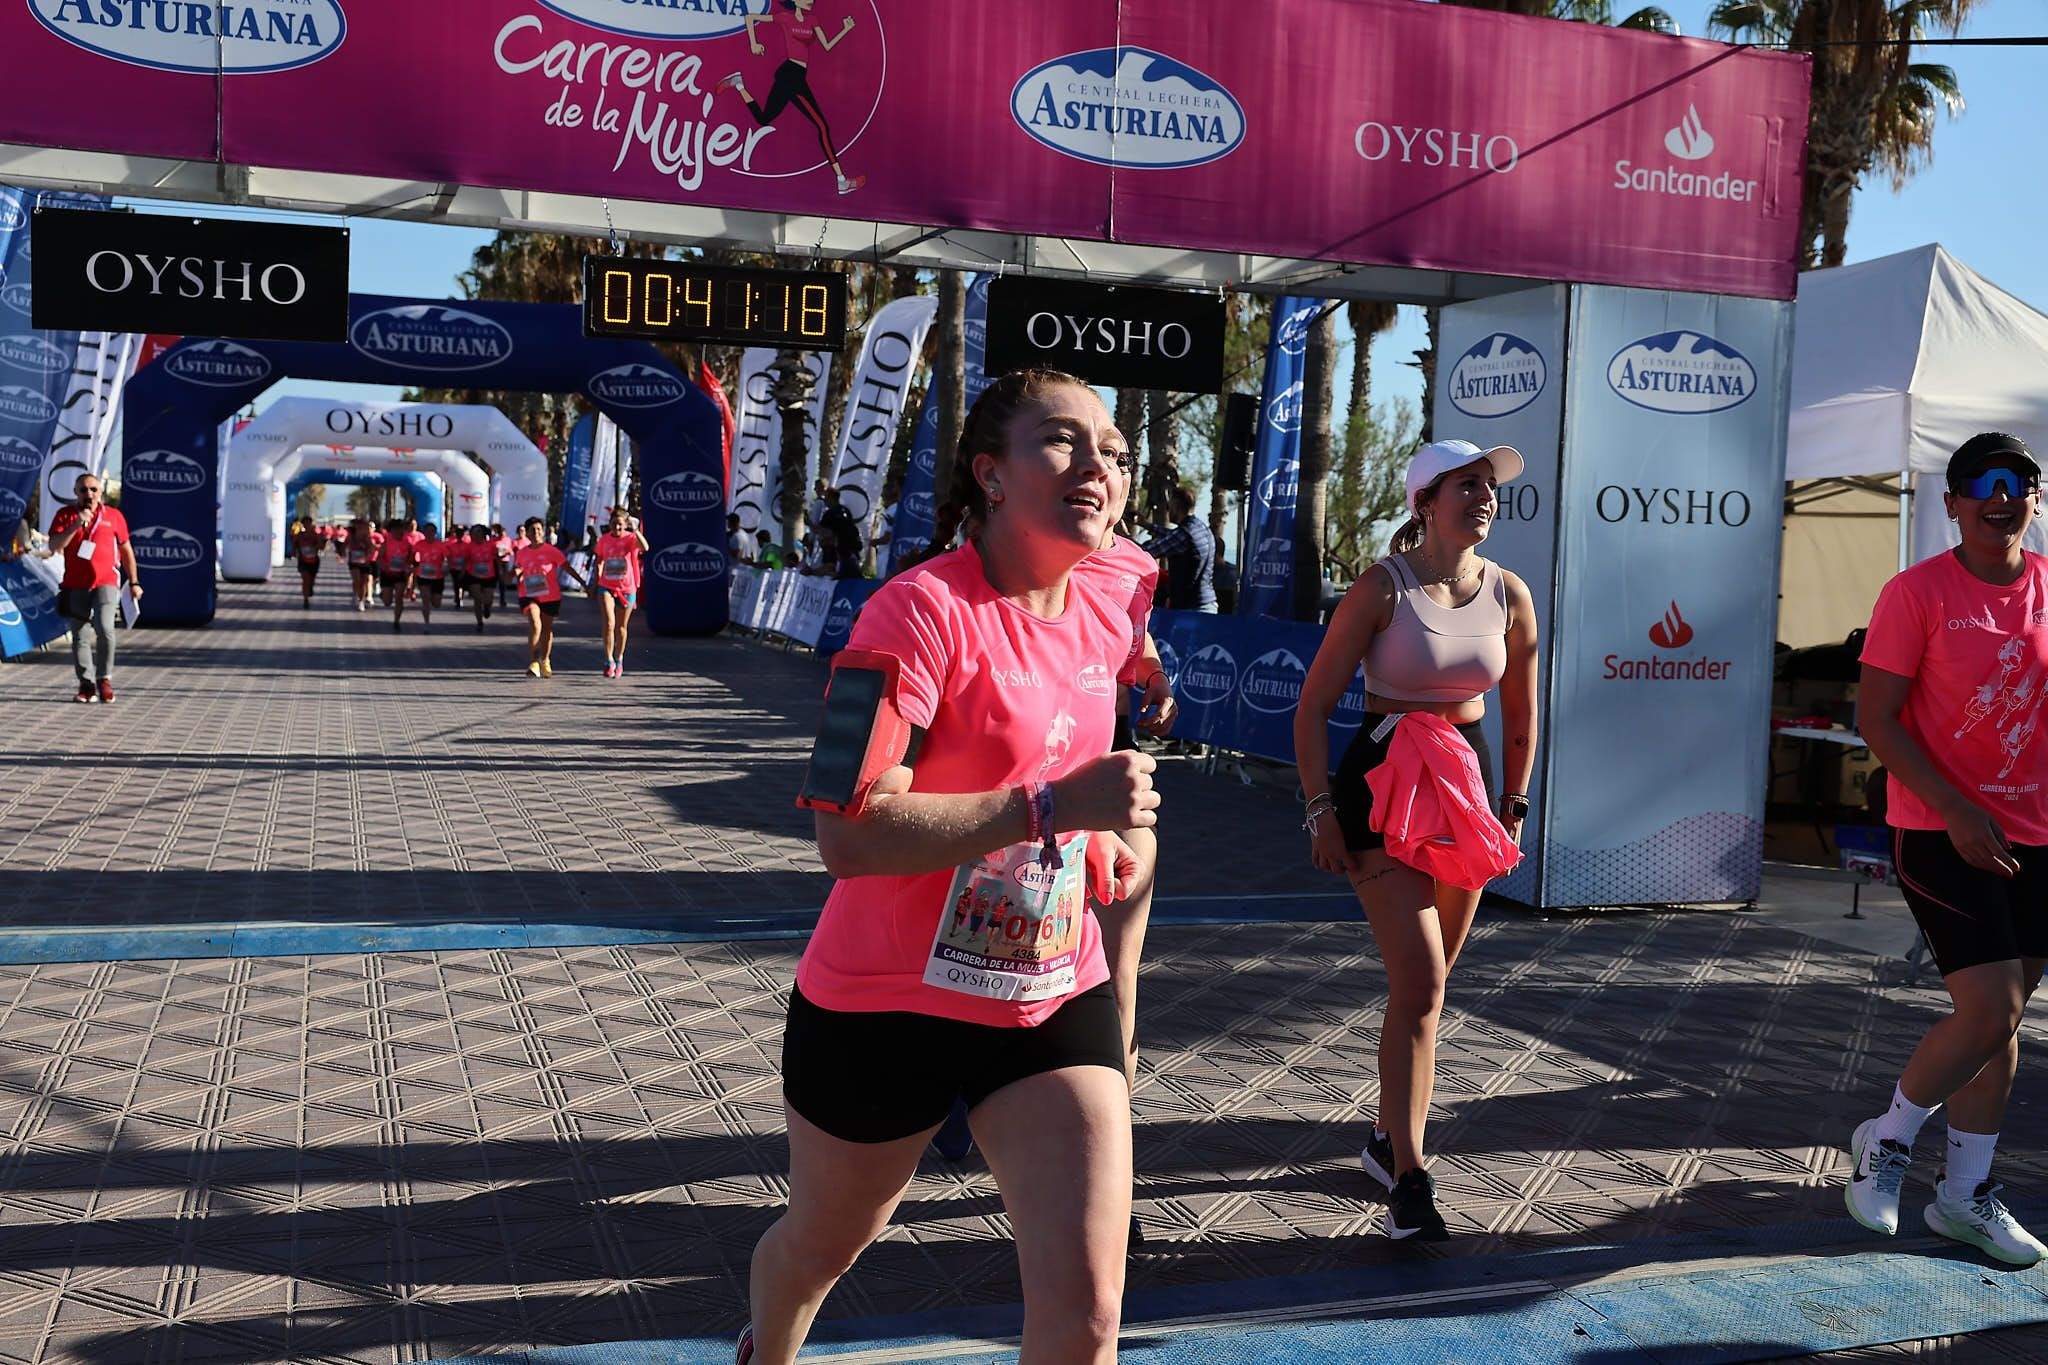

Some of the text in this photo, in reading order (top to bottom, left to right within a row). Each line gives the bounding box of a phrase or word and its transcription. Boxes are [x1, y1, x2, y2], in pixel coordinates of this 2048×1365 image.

[53, 0, 322, 46] ASTURIANA
[494, 15, 702, 94] Carrera
[1029, 82, 1227, 144] ASTURIANA
[1067, 83, 1221, 109] CENTRAL LECHERA
[544, 86, 776, 191] de la Mujer
[1354, 121, 1519, 173] OYSHO
[1614, 160, 1757, 202] Santander
[86, 250, 305, 305] OYSHO
[604, 271, 828, 335] 00:41:18
[364, 321, 500, 357] ASTURIANA
[1026, 312, 1191, 358] OYSHO
[171, 355, 263, 377] ASTURIANA
[1617, 358, 1745, 396] ASTURIANA
[597, 380, 679, 397] ASTURIANA
[1454, 369, 1539, 400] ASTURIANA
[48, 340, 101, 506] OYSH
[326, 408, 454, 438] OYSHO
[838, 331, 912, 523] OYSHO
[127, 467, 200, 484] ASTURIANA
[655, 486, 720, 501] ASTURIANA
[1596, 485, 1751, 527] OYSHO
[133, 545, 198, 560] STURIANA
[657, 557, 722, 572] ASTURIANA
[1183, 664, 1232, 691] ASTURIANA
[1603, 654, 1731, 680] Santander
[943, 948, 987, 967] CARRERA
[989, 959, 1001, 969] DE
[1002, 961, 1015, 971] LA
[1017, 962, 1045, 974] MUJER
[1011, 949, 1041, 960] 4384
